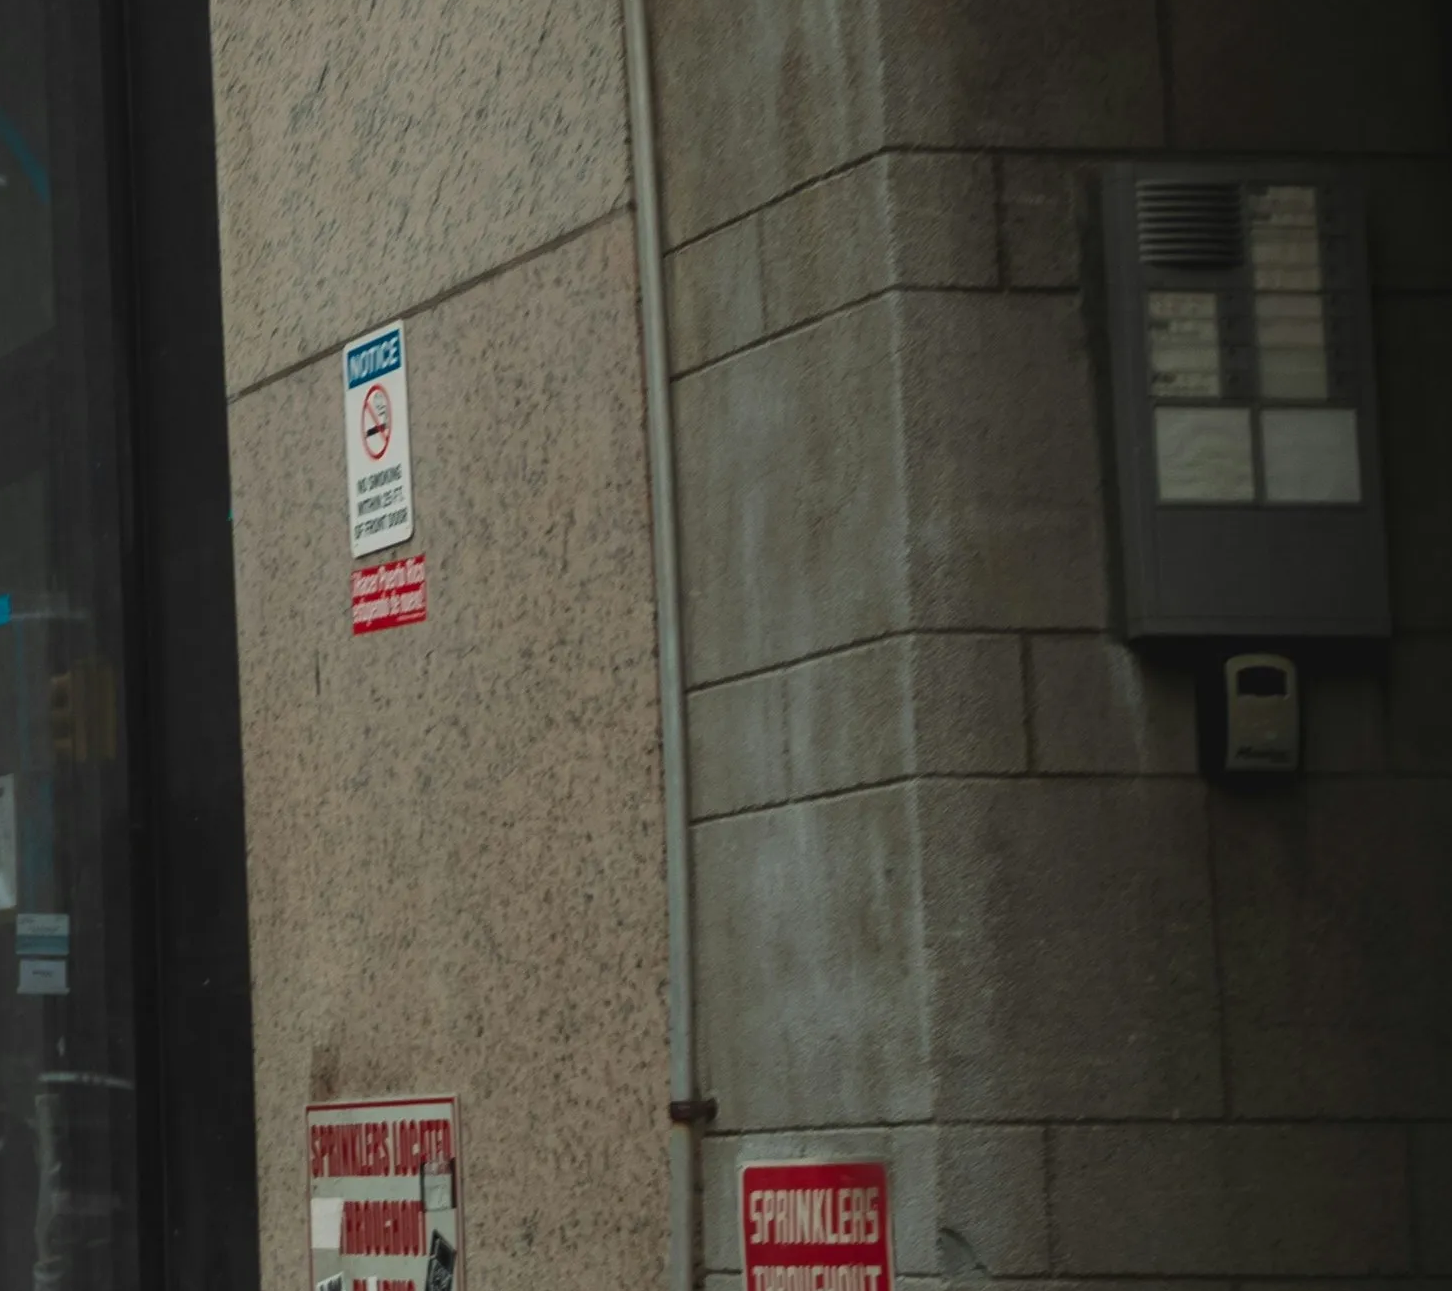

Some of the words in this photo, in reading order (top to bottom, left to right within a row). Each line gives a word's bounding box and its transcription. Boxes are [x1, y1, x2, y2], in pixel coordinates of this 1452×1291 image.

[349, 335, 399, 379] NOTICE
[356, 478, 367, 494] NO
[368, 463, 402, 491] SMOKING
[311, 1120, 390, 1178] SPRINKLERS
[750, 1186, 880, 1245] SPRINKLERS
